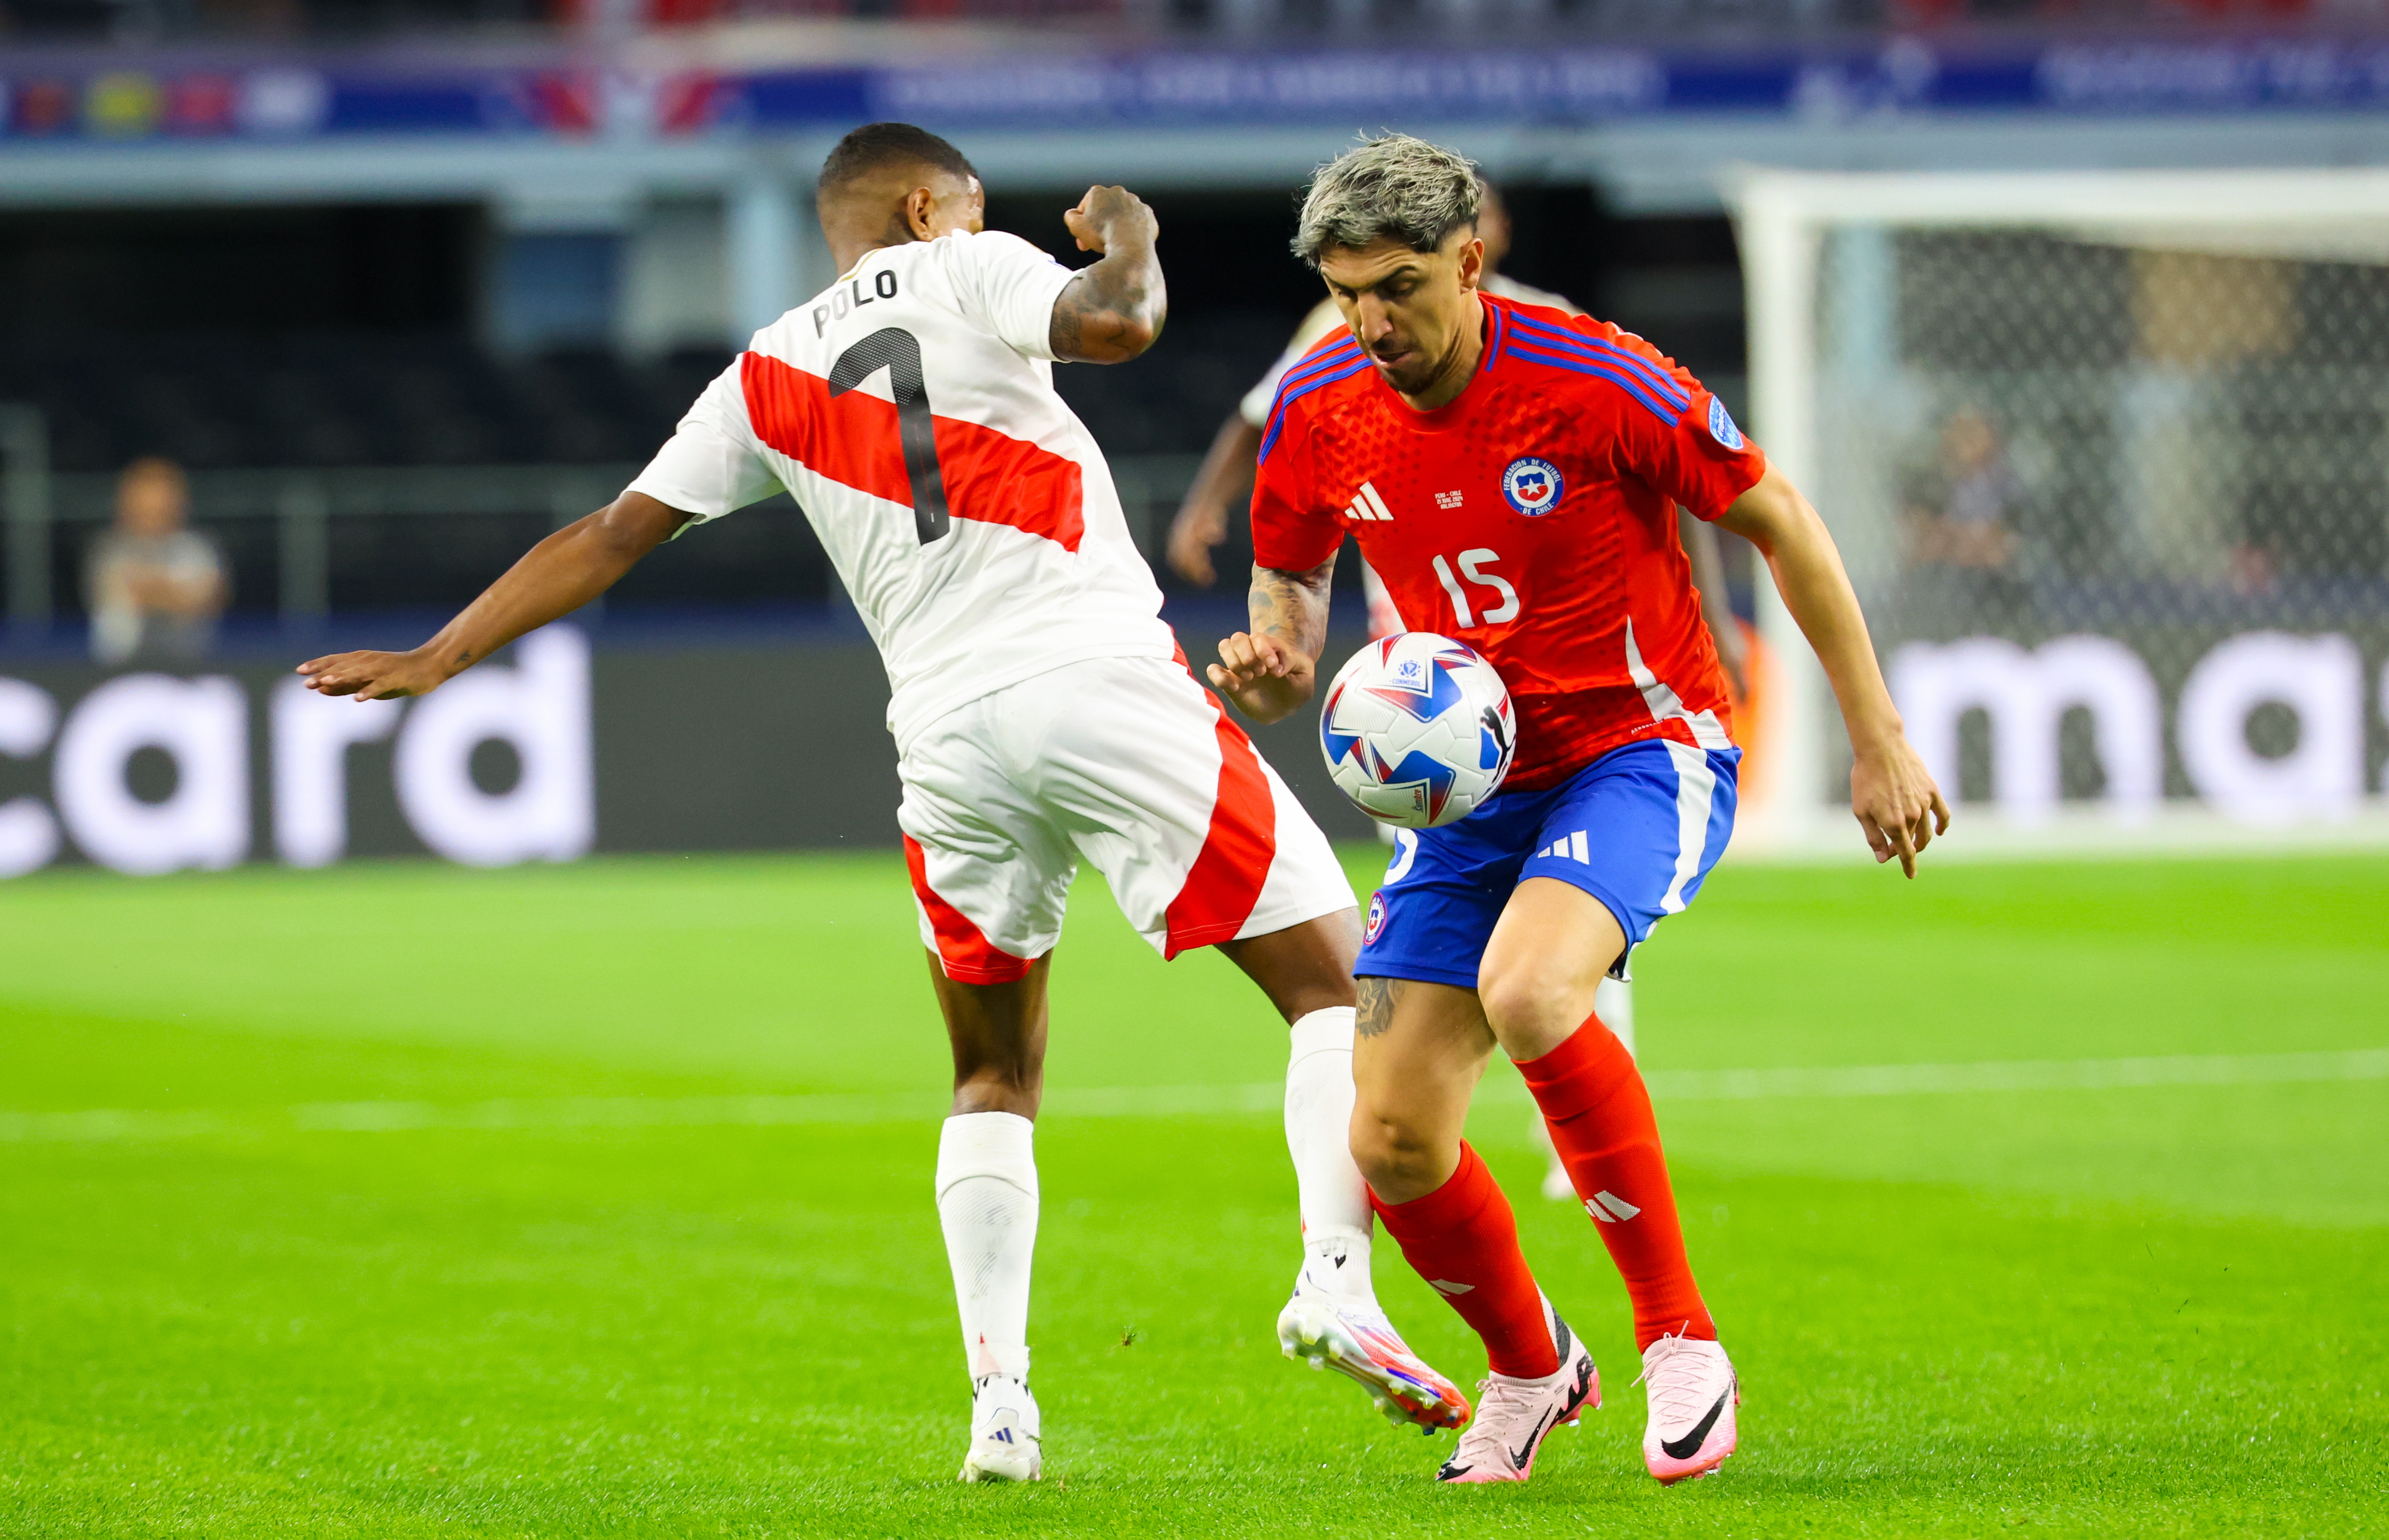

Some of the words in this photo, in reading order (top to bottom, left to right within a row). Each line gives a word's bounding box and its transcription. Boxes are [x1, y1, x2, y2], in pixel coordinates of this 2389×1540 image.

[813, 270, 898, 339] POLO
[828, 327, 950, 547] 7
[1503, 459, 1527, 490] FEDERACION
[1542, 462, 1562, 483] FUTBOL
[1535, 502, 1554, 515] CHILE
[1432, 548, 1520, 629] 15
[1392, 678, 1421, 687] CONMEBOL
[1893, 629, 2389, 829] ma
